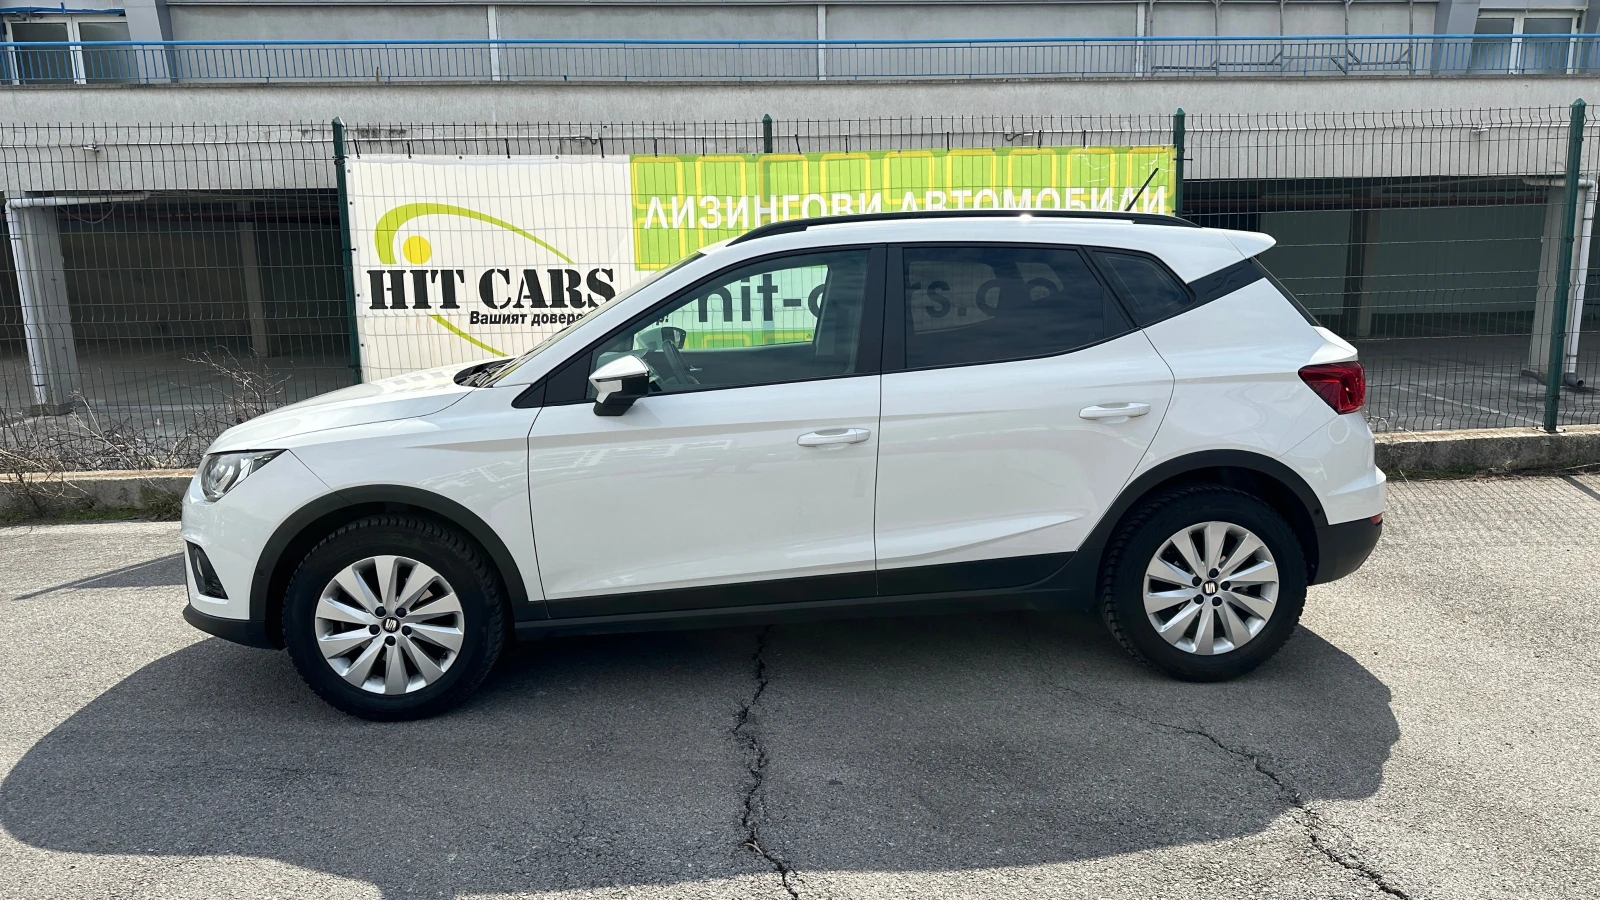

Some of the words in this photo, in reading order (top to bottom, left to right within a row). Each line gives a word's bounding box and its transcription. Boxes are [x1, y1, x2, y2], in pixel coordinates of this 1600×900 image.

[644, 192, 882, 229] ЛИЗИНГОВИ
[901, 186, 1165, 215] АВТОМОБИЛИ
[367, 269, 465, 309] HIT
[478, 268, 616, 309] CARS
[470, 311, 527, 325] Вашият
